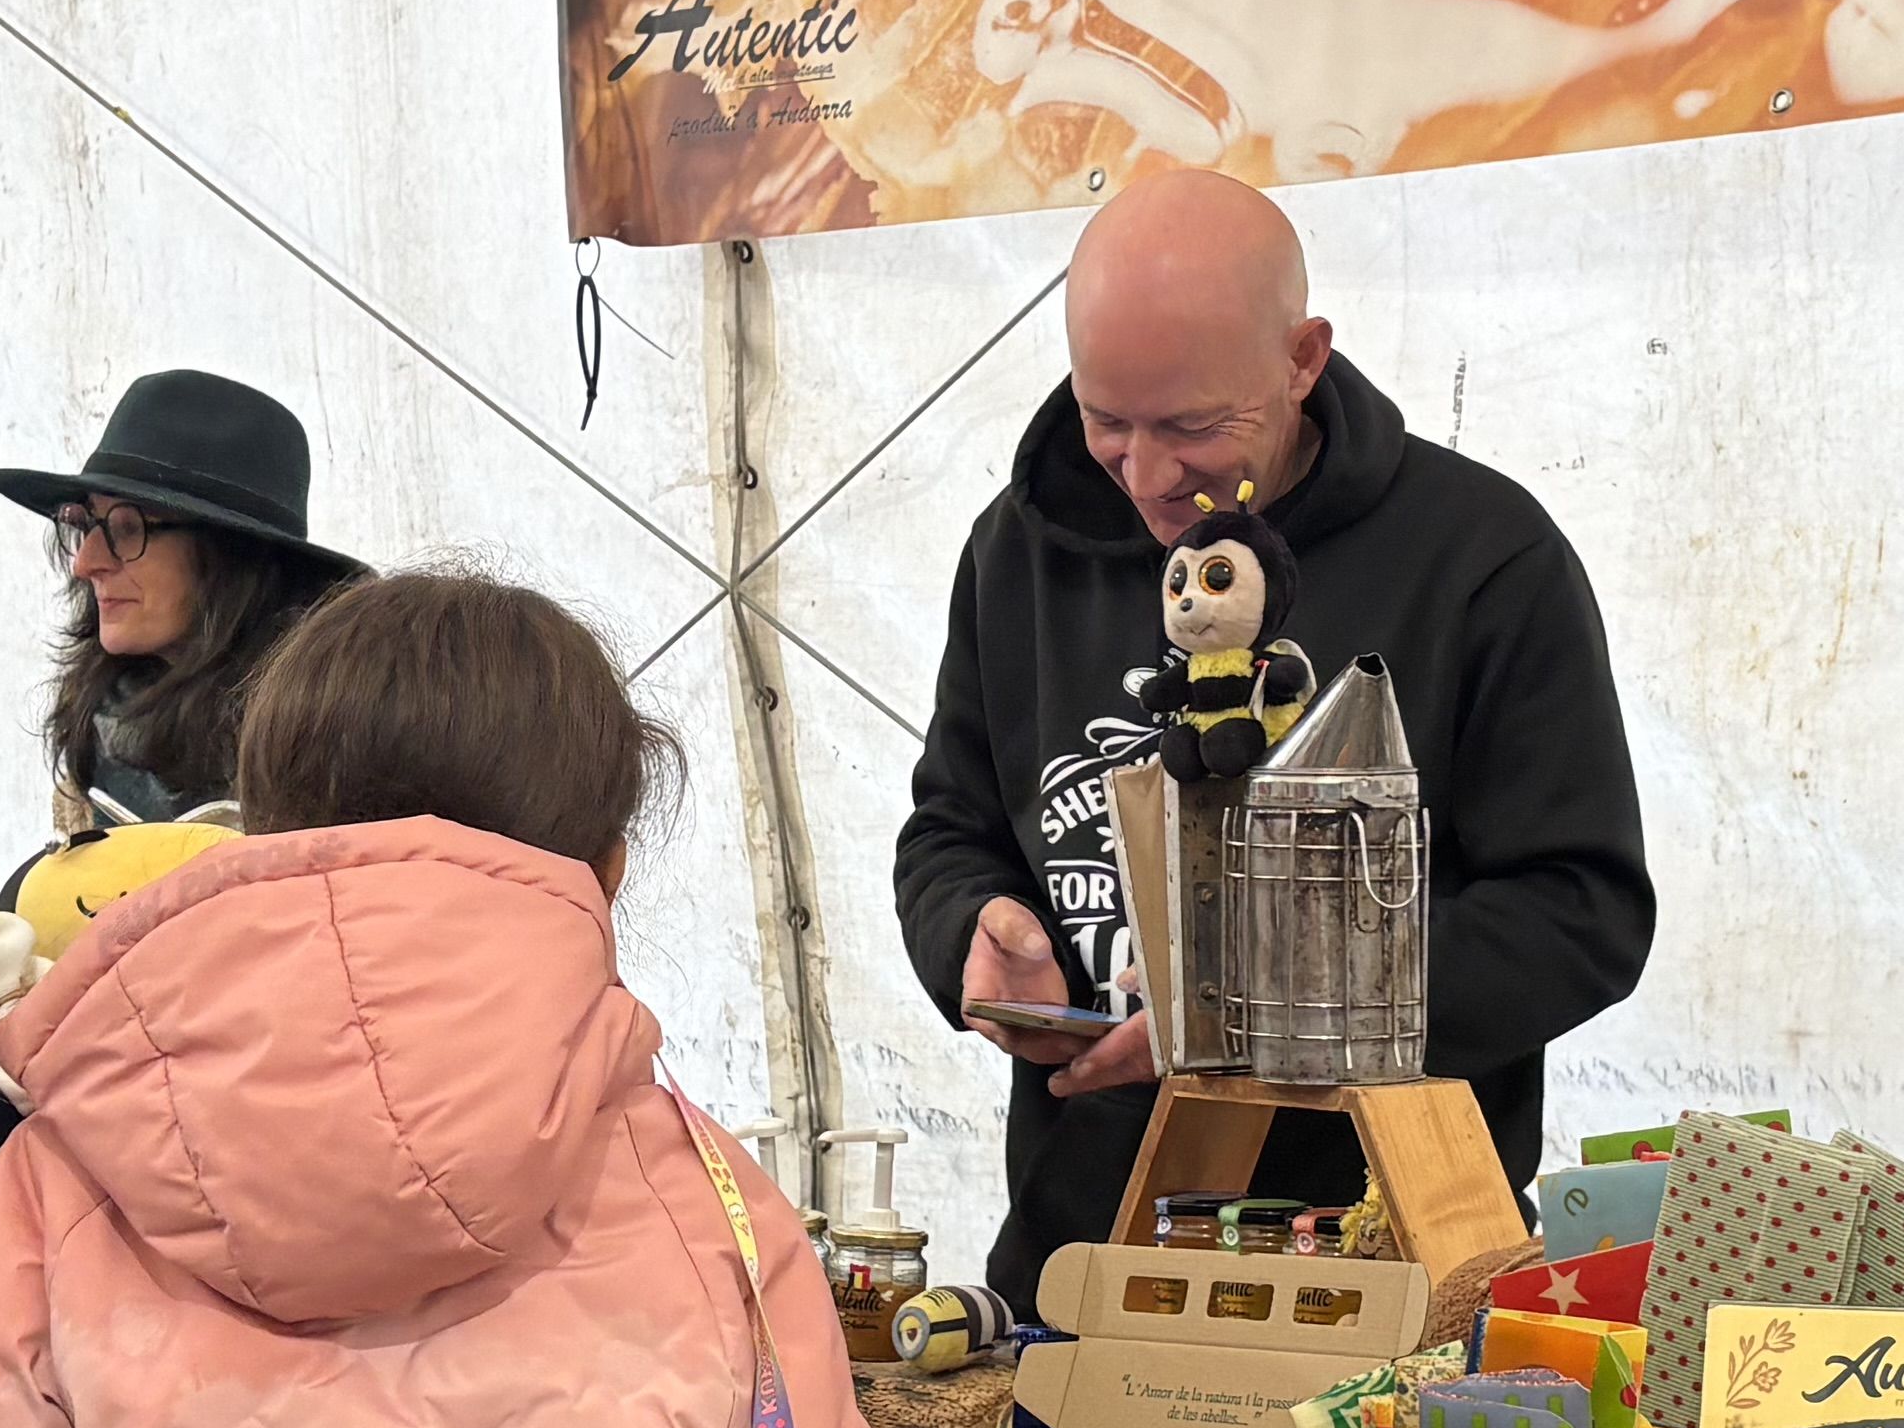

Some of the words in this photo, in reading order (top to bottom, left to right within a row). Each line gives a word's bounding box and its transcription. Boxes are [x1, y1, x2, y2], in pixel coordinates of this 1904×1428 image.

[766, 96, 852, 128] Andorra
[1047, 872, 1115, 911] FOR
[1176, 1386, 1189, 1400] de
[1193, 1388, 1202, 1401] la
[1206, 1391, 1241, 1405] natura
[1253, 1398, 1263, 1408] la
[1167, 1406, 1181, 1419] de
[1183, 1407, 1197, 1420] les
